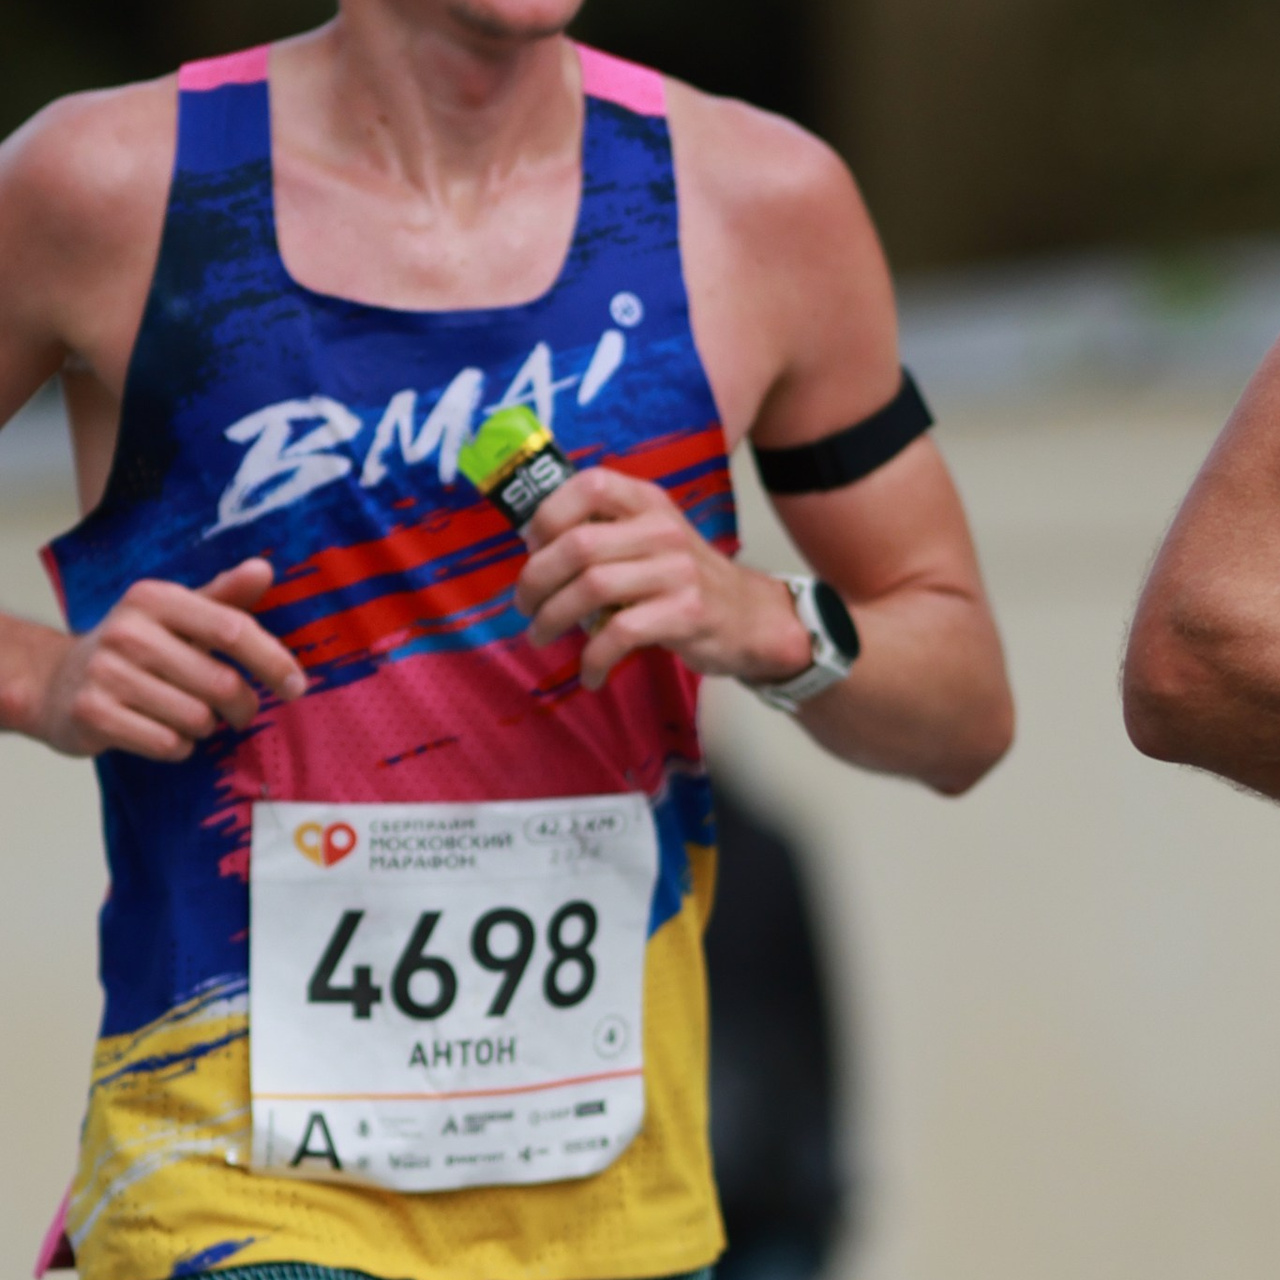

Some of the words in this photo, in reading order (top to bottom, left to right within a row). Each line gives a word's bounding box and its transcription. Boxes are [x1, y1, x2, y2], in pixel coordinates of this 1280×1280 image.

[369, 832, 514, 852] МОСКОВСКИЙ
[369, 854, 476, 871] МАРАФОН
[306, 899, 598, 1020] 4698
[408, 1038, 516, 1068] АНТОН
